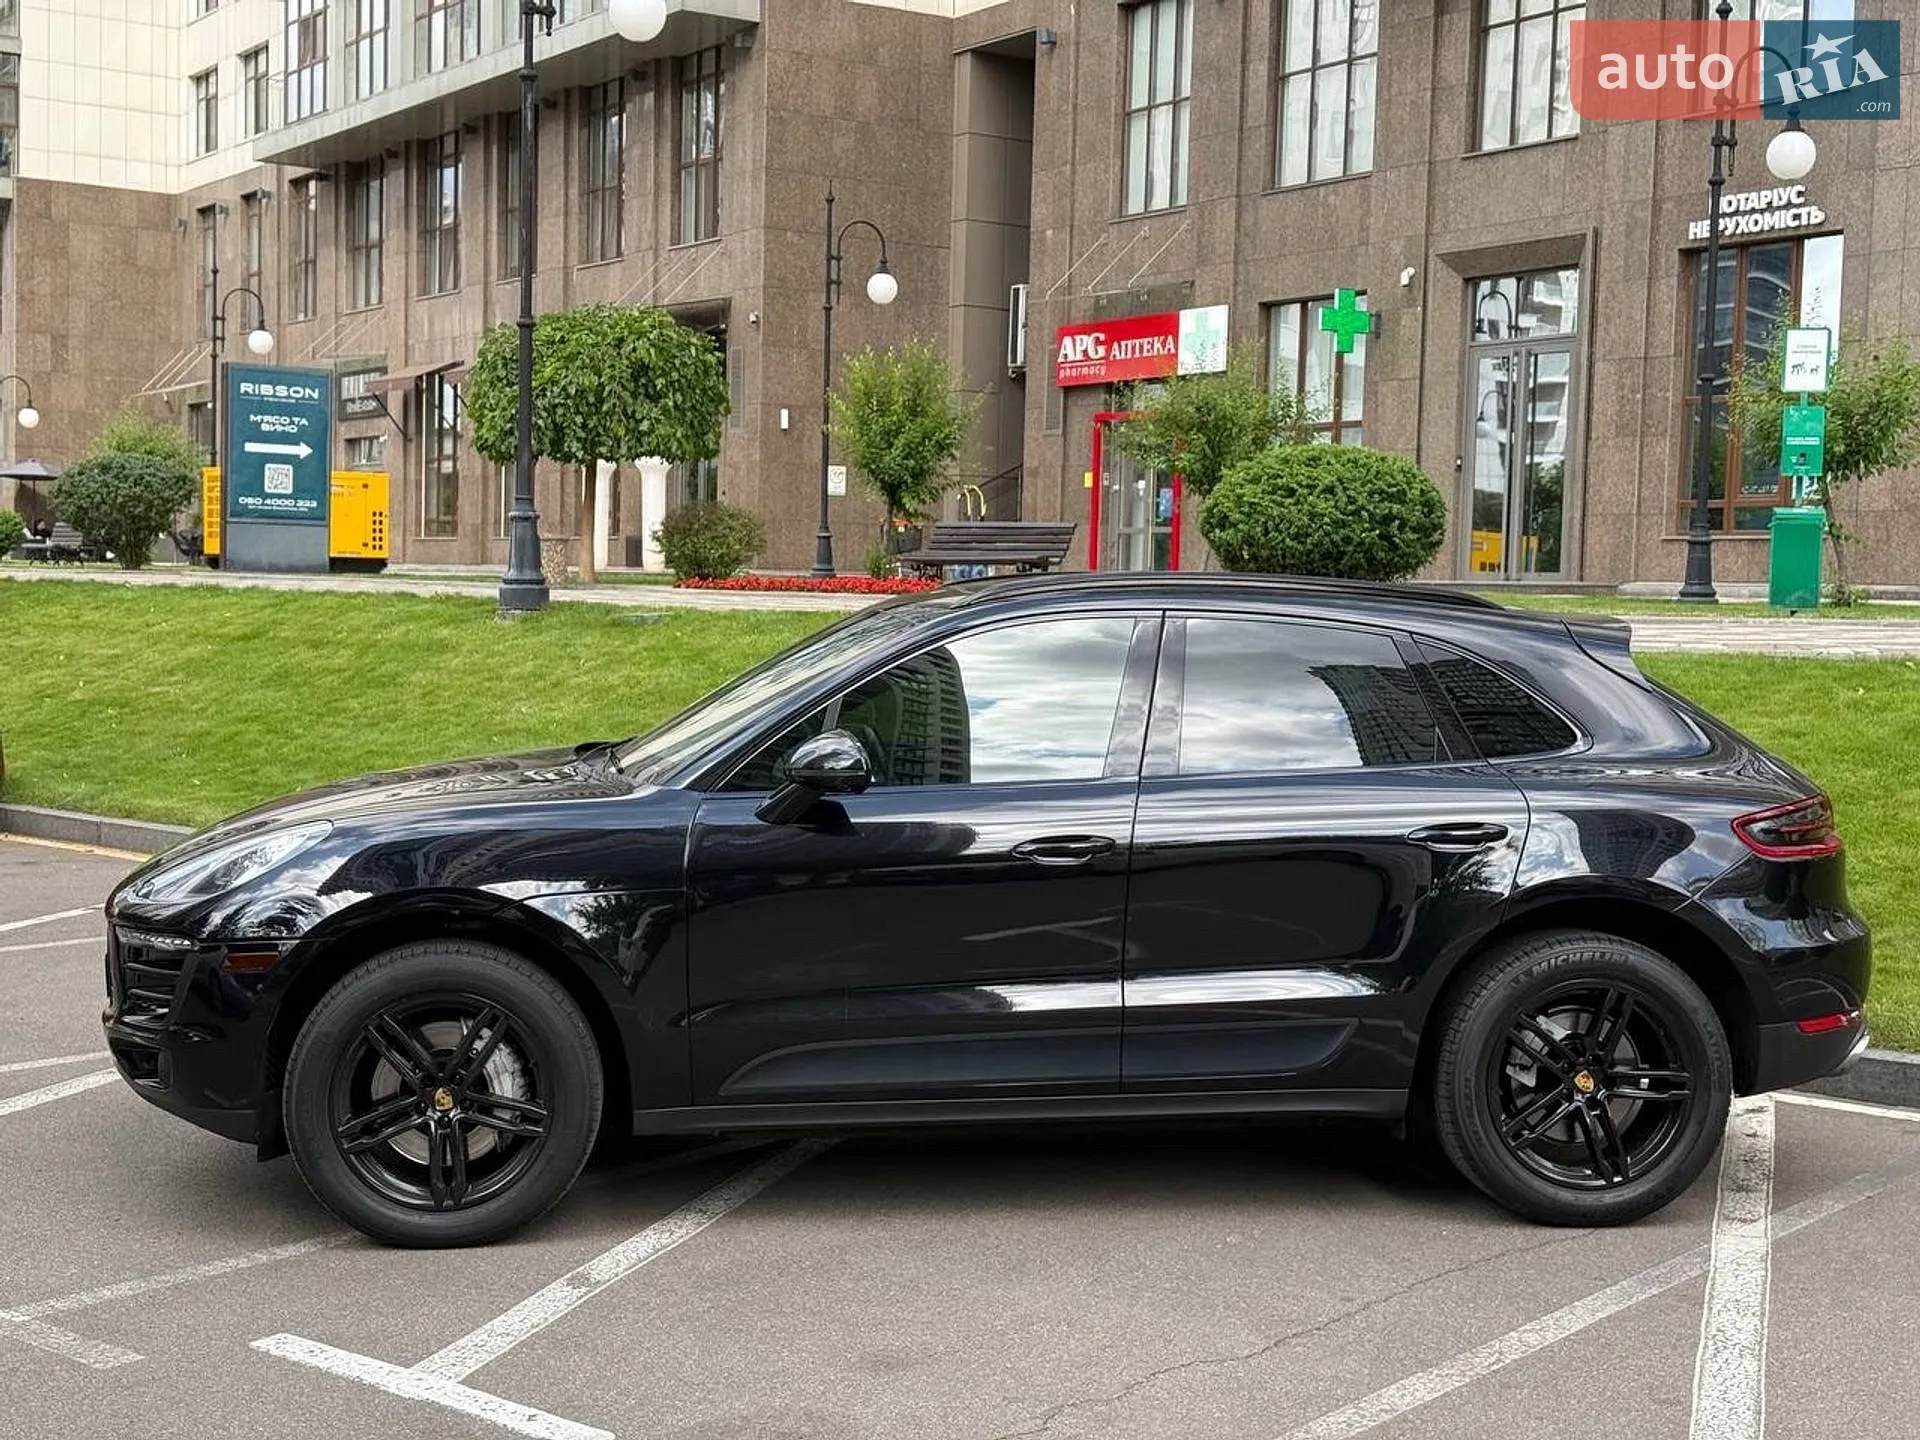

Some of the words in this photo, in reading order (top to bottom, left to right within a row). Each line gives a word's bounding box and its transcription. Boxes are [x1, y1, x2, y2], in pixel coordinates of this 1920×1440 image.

[1057, 333, 1107, 362] APG
[1110, 335, 1175, 360] АПТЕКА
[1059, 364, 1106, 378] pharmacy
[240, 382, 319, 399] RIBSON
[261, 422, 298, 433] ВИНО
[291, 416, 309, 426] ТА
[1532, 952, 1628, 976] MICHELIN
